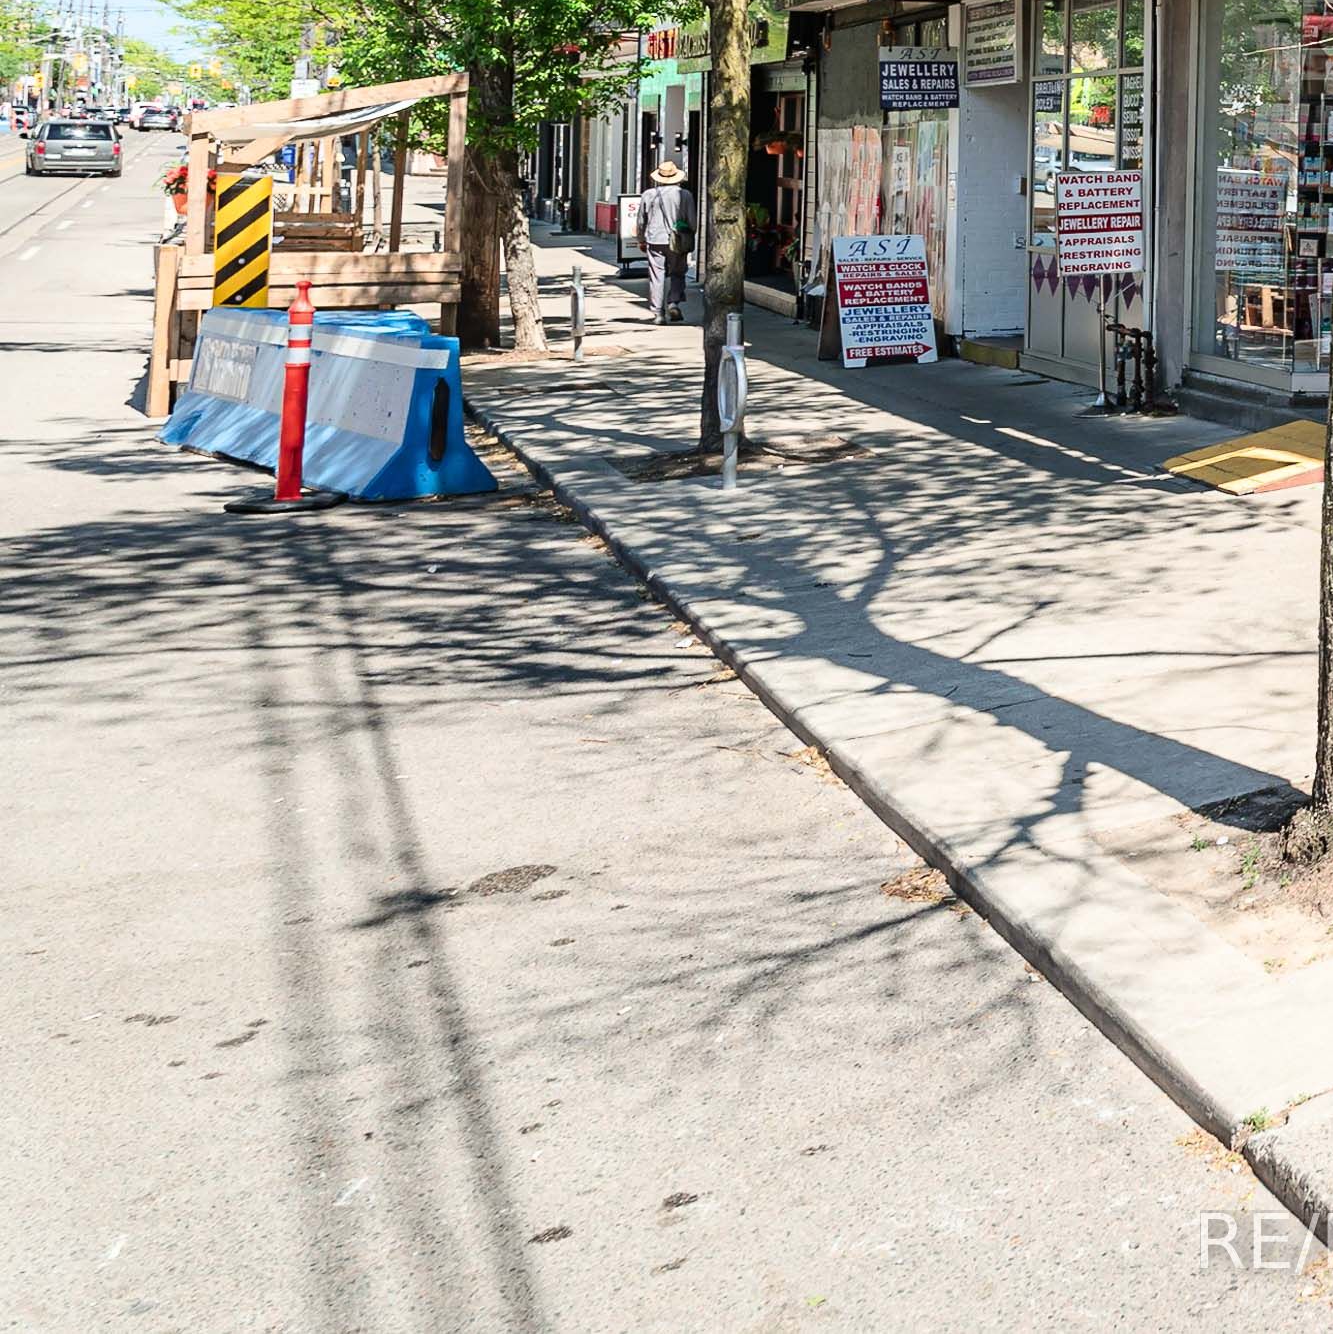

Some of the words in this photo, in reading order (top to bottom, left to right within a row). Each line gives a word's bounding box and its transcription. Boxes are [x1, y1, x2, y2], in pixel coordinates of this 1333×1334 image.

[881, 63, 955, 77] JEWELLERY
[882, 78, 910, 90] SALES
[911, 78, 918, 90] &
[920, 78, 956, 90] REPAIRS
[1058, 174, 1103, 185] WATCH
[1106, 173, 1141, 183] BAND
[1064, 189, 1073, 198] &
[1077, 187, 1133, 197] BATTERY
[1058, 199, 1141, 211] REPLACEMENT
[1059, 216, 1109, 231] JEWELLERY
[1110, 214, 1141, 229] REPAIR
[841, 264, 876, 272] WATCH
[843, 283, 883, 291] WATCH
[865, 289, 914, 297] BATTERY
[844, 296, 925, 305] REPLACEMENT
[844, 306, 928, 316] JEWELLERY
[888, 314, 930, 322] REPAIRS
[850, 347, 873, 358] FREE
[874, 345, 924, 357] ESTIMATES
